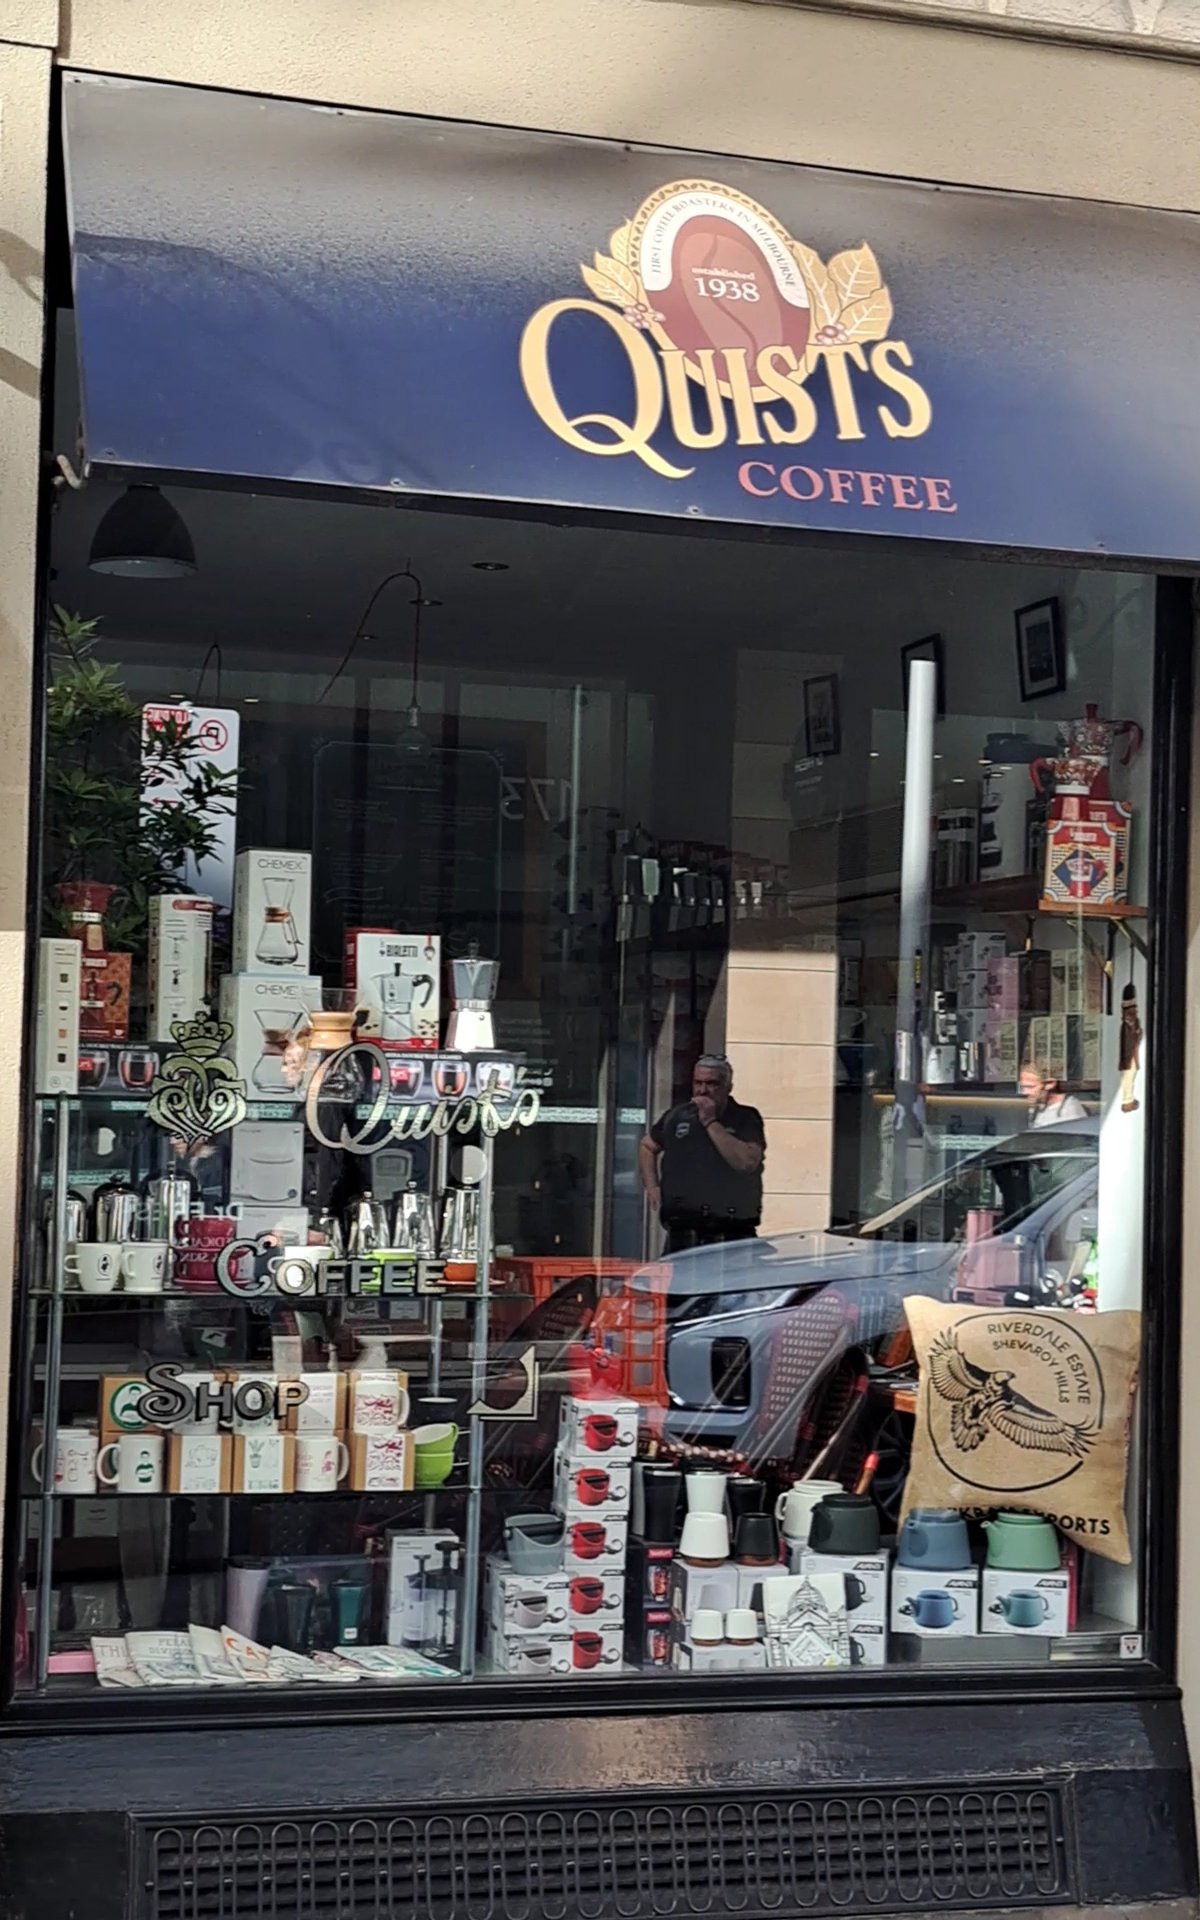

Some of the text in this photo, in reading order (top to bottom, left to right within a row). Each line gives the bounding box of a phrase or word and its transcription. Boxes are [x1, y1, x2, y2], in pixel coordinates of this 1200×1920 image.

[672, 198, 735, 213] ROASTERS
[736, 211, 751, 223] IN
[752, 223, 796, 286] MELBOURNE
[694, 277, 760, 303] 1938
[519, 297, 933, 479] QUISTS
[737, 460, 958, 513] COFFEE
[257, 858, 304, 870] CHEMEX
[215, 1233, 447, 1298] COFFEE
[137, 1362, 310, 1424] SHOP
[987, 1322, 1091, 1405] RIVERDALE ESTATE
[992, 1339, 1070, 1404] SHEVAROY HILLS
